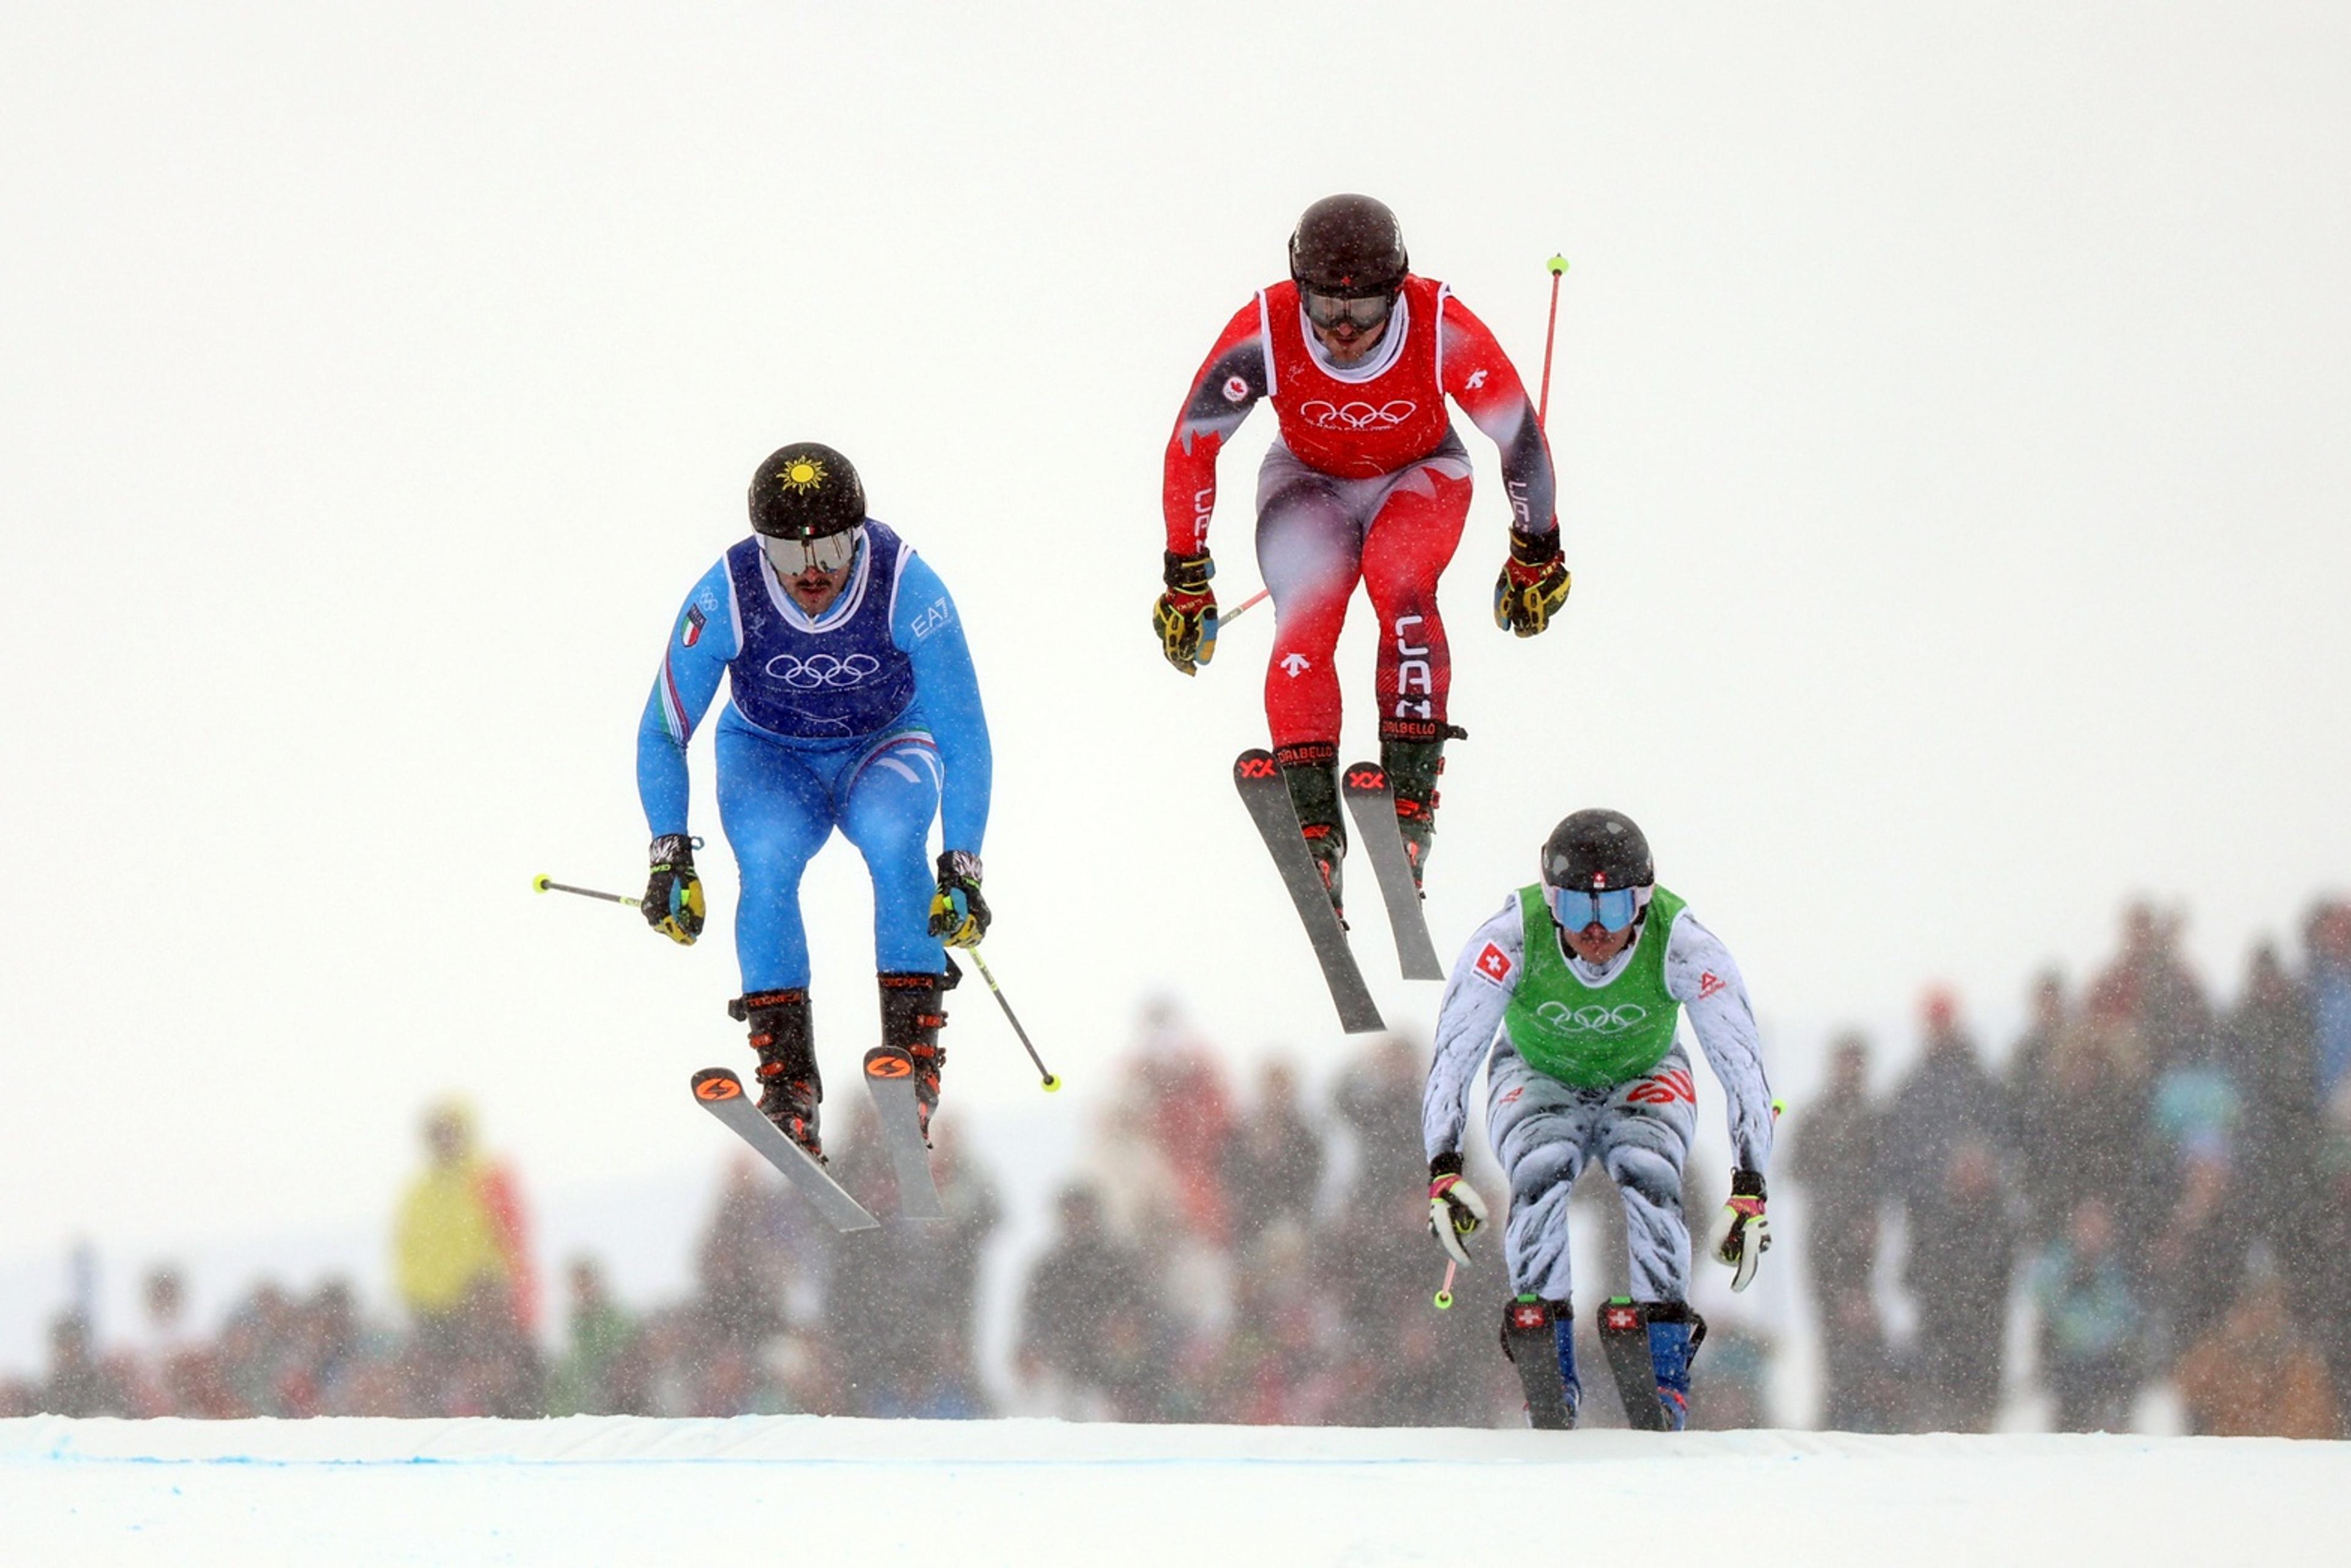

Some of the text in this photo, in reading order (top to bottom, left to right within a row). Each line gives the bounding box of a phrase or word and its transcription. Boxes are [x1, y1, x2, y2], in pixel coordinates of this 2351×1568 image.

[1508, 475, 1529, 531] CA
[911, 597, 948, 637] EA7
[1277, 746, 1333, 763] DALBELLO
